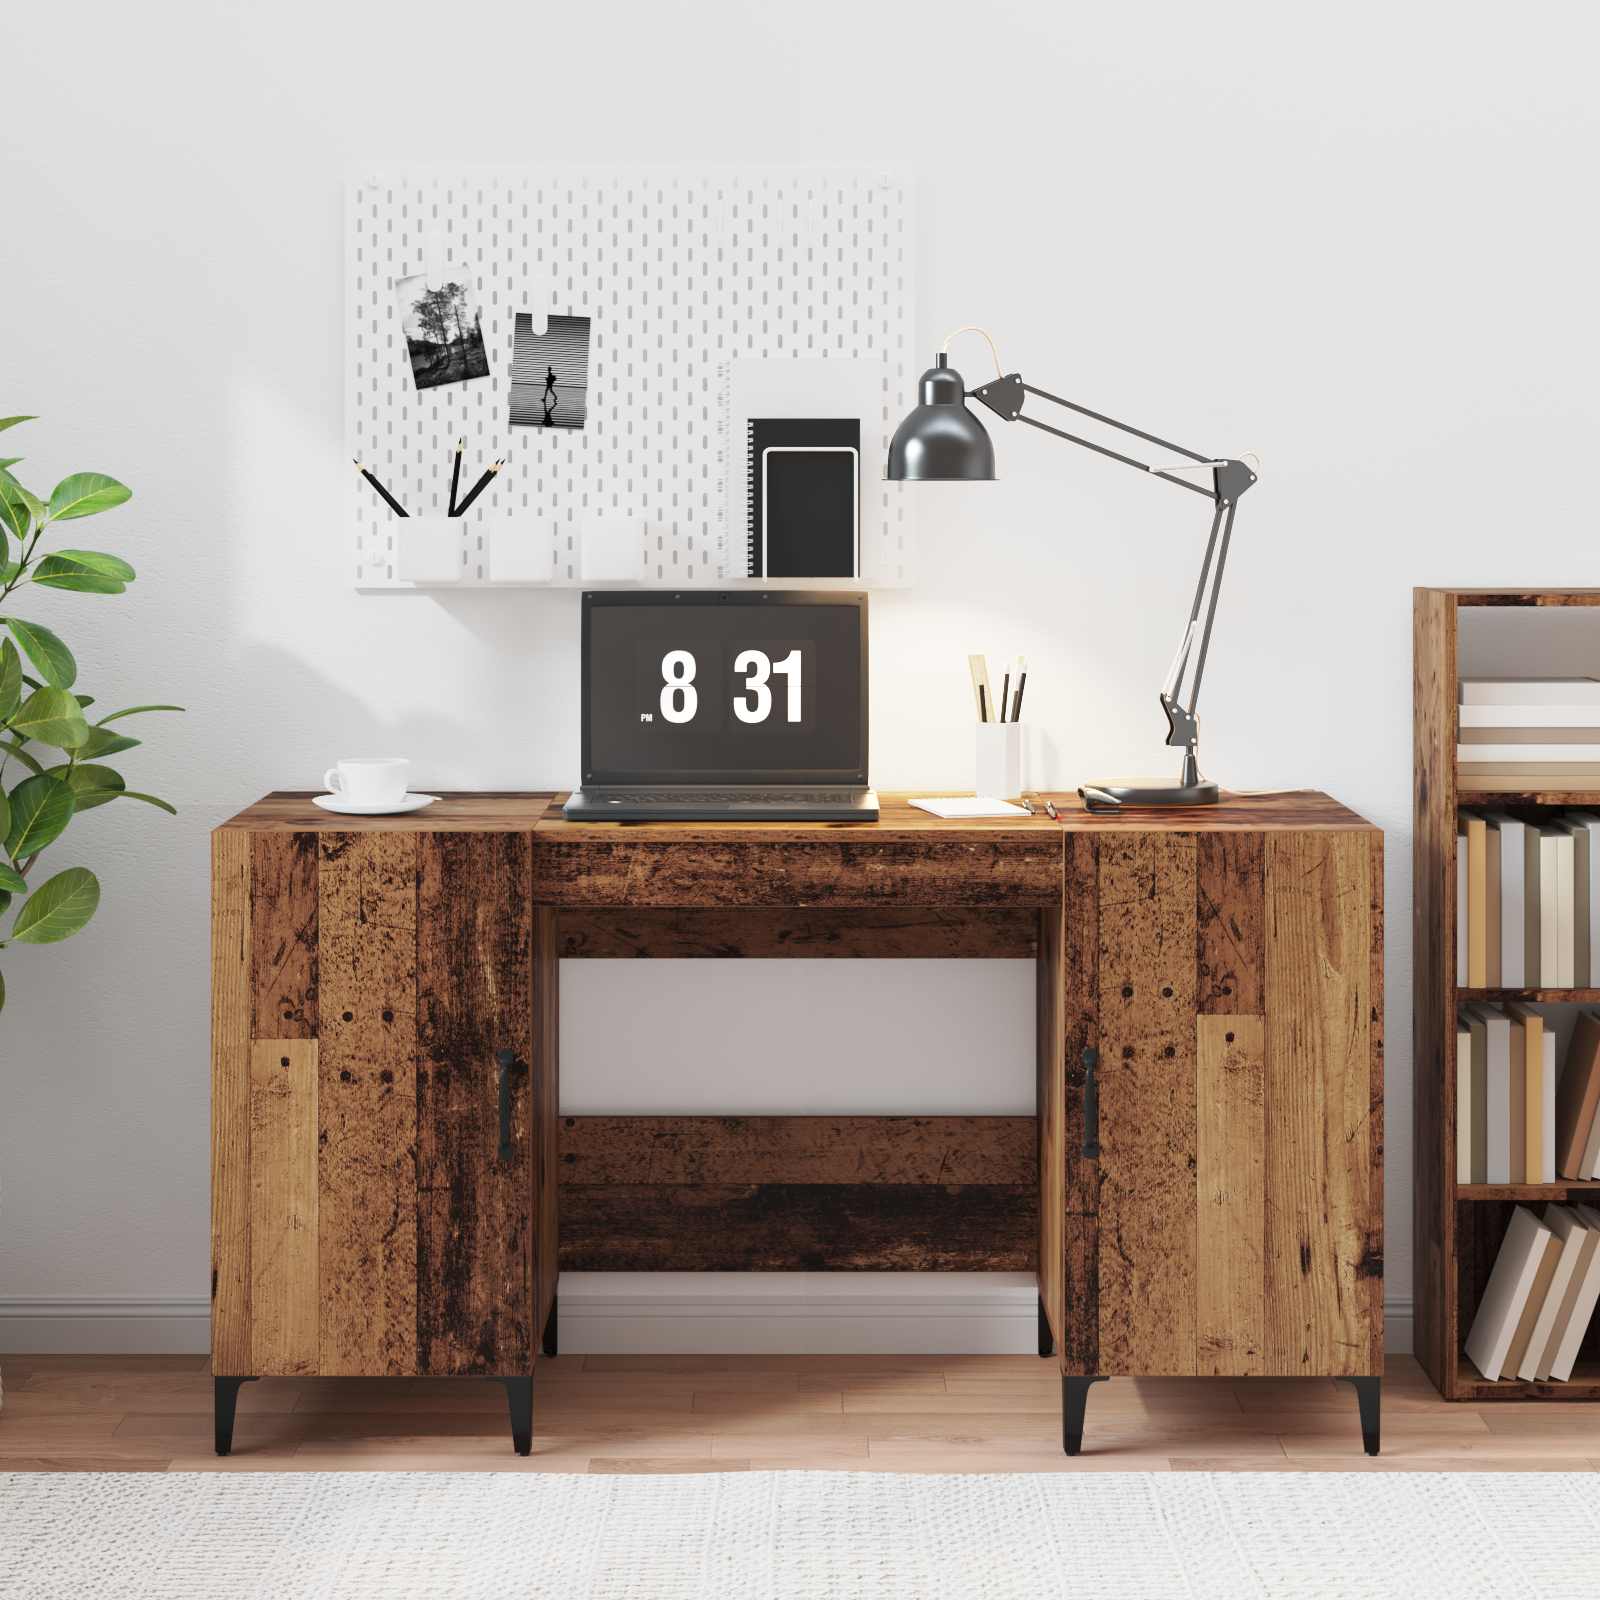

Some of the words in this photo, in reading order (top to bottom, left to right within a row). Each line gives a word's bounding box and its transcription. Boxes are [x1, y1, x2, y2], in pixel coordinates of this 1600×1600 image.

[640, 713, 653, 722] PM
[659, 649, 698, 724] 8
[733, 649, 802, 724] 31
